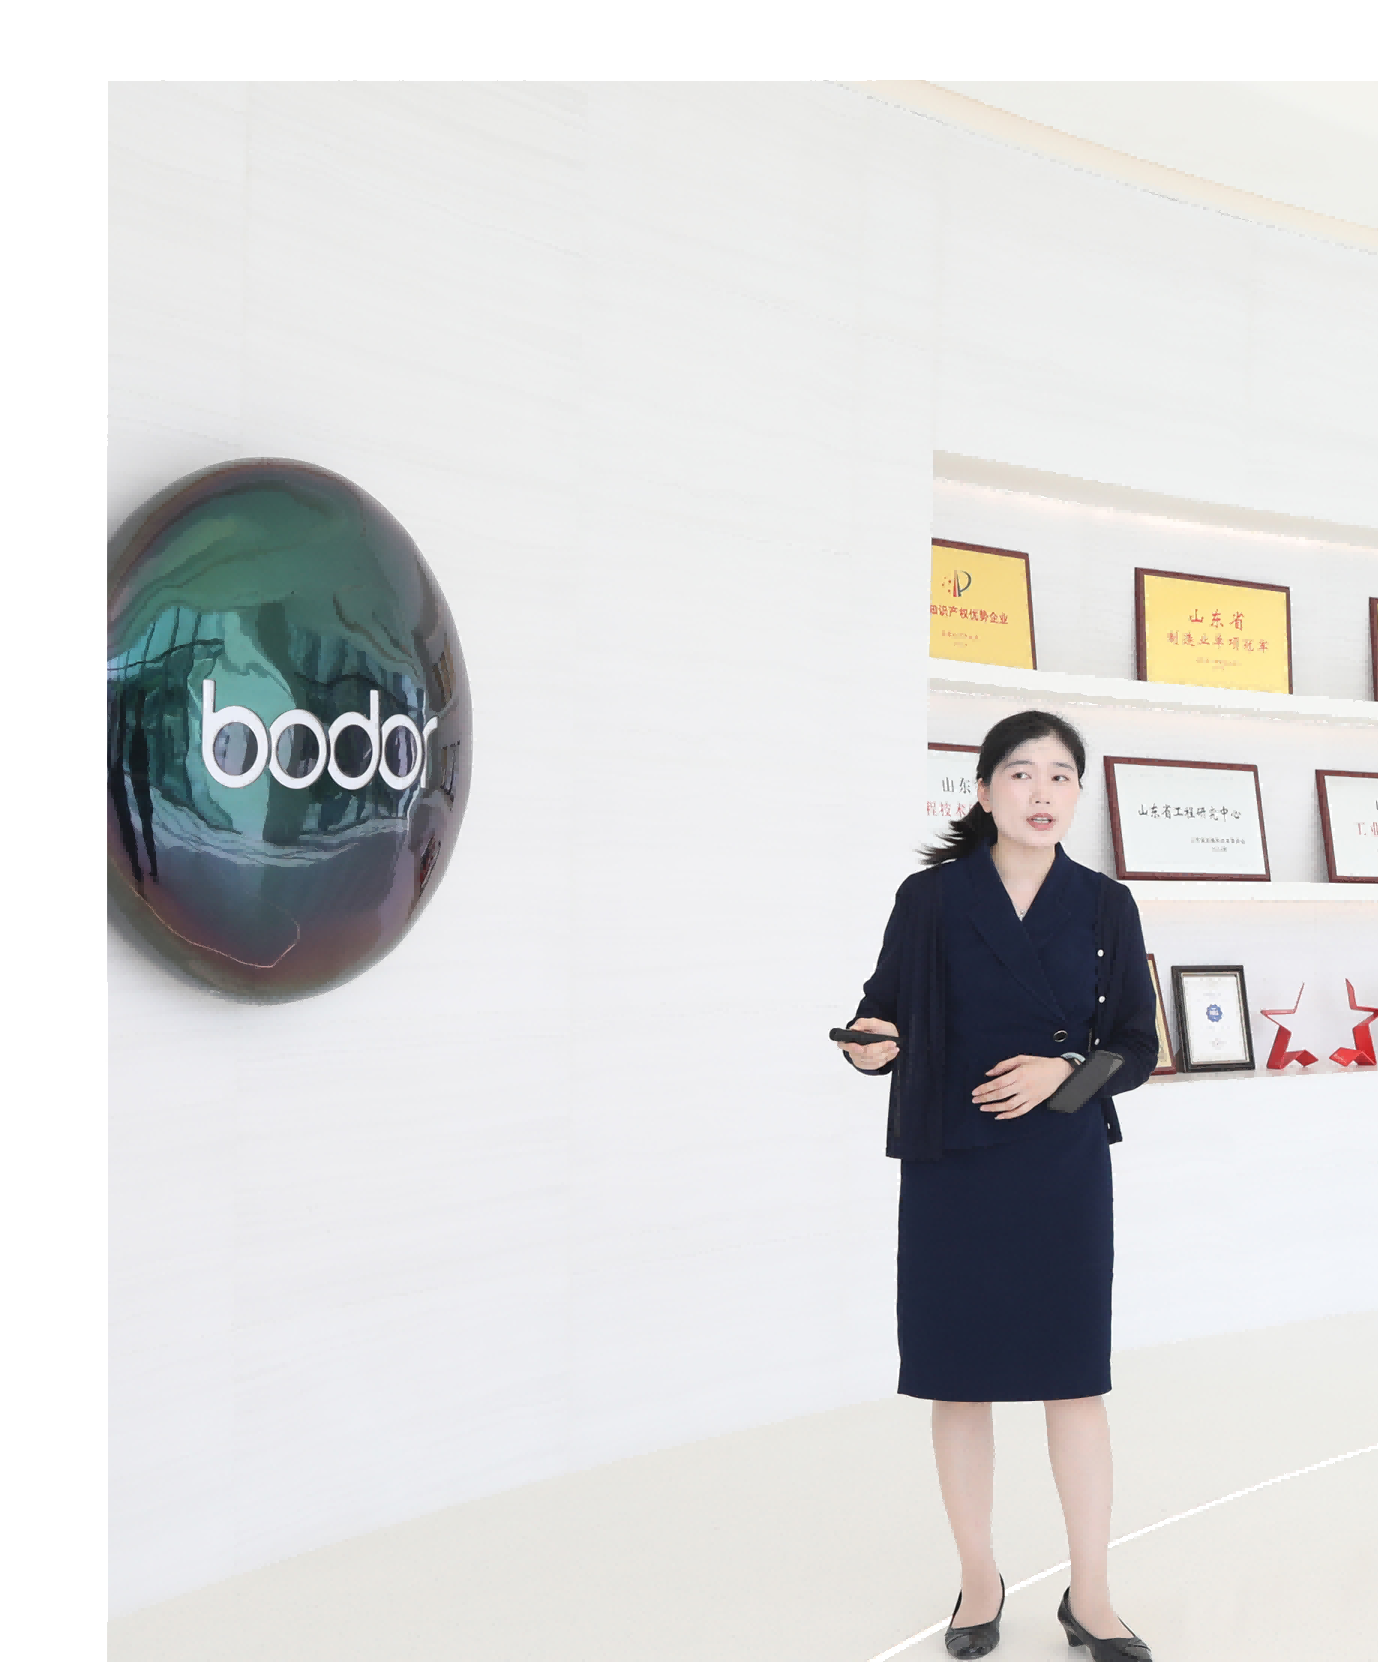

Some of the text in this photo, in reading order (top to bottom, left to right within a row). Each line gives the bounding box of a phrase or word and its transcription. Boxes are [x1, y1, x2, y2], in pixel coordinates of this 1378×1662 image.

[1188, 608, 1245, 631] 山东省
[202, 679, 439, 790] bodor
[941, 776, 977, 794] 山东
[1138, 802, 1242, 822] 山东省工程研究中心
